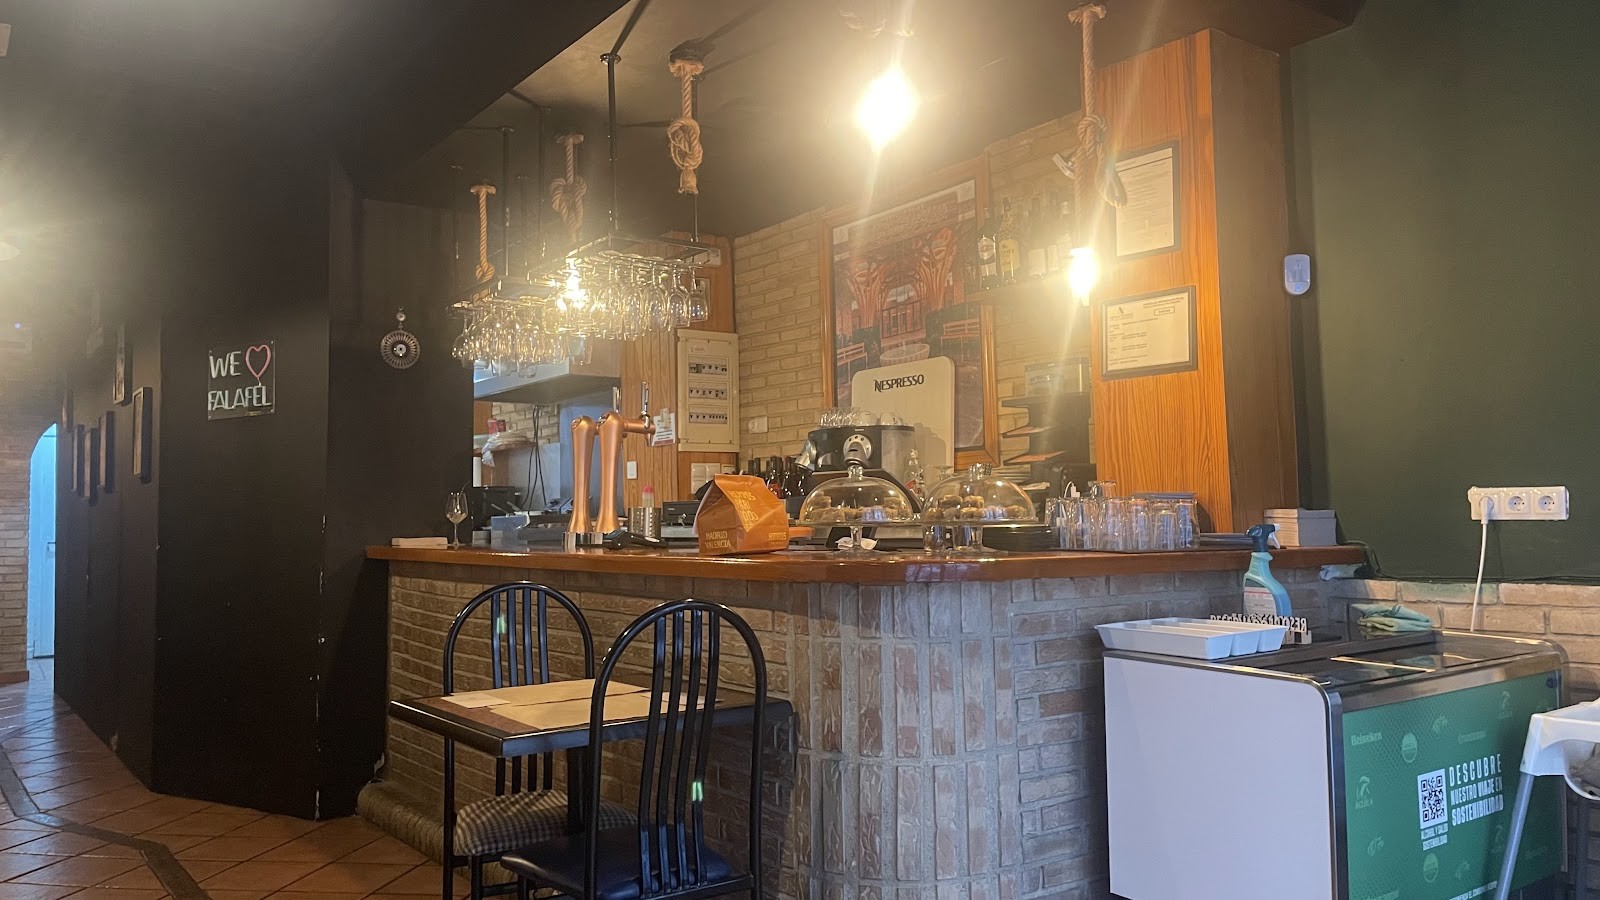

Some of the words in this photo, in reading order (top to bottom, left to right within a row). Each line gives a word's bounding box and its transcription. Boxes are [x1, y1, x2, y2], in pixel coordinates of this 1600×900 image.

[209, 351, 241, 378] WE
[874, 373, 925, 393] NESPRESSO
[208, 385, 272, 411] FALAFEL
[704, 539, 732, 549] VALENCIA
[705, 530, 728, 540] MADRID
[1449, 754, 1502, 787] DESCUBRE
[1450, 782, 1478, 806] NUESTRO
[1478, 779, 1495, 798] VIAJE
[1495, 776, 1503, 792] EN
[1451, 794, 1504, 827] SOSTENIBILIDAD
